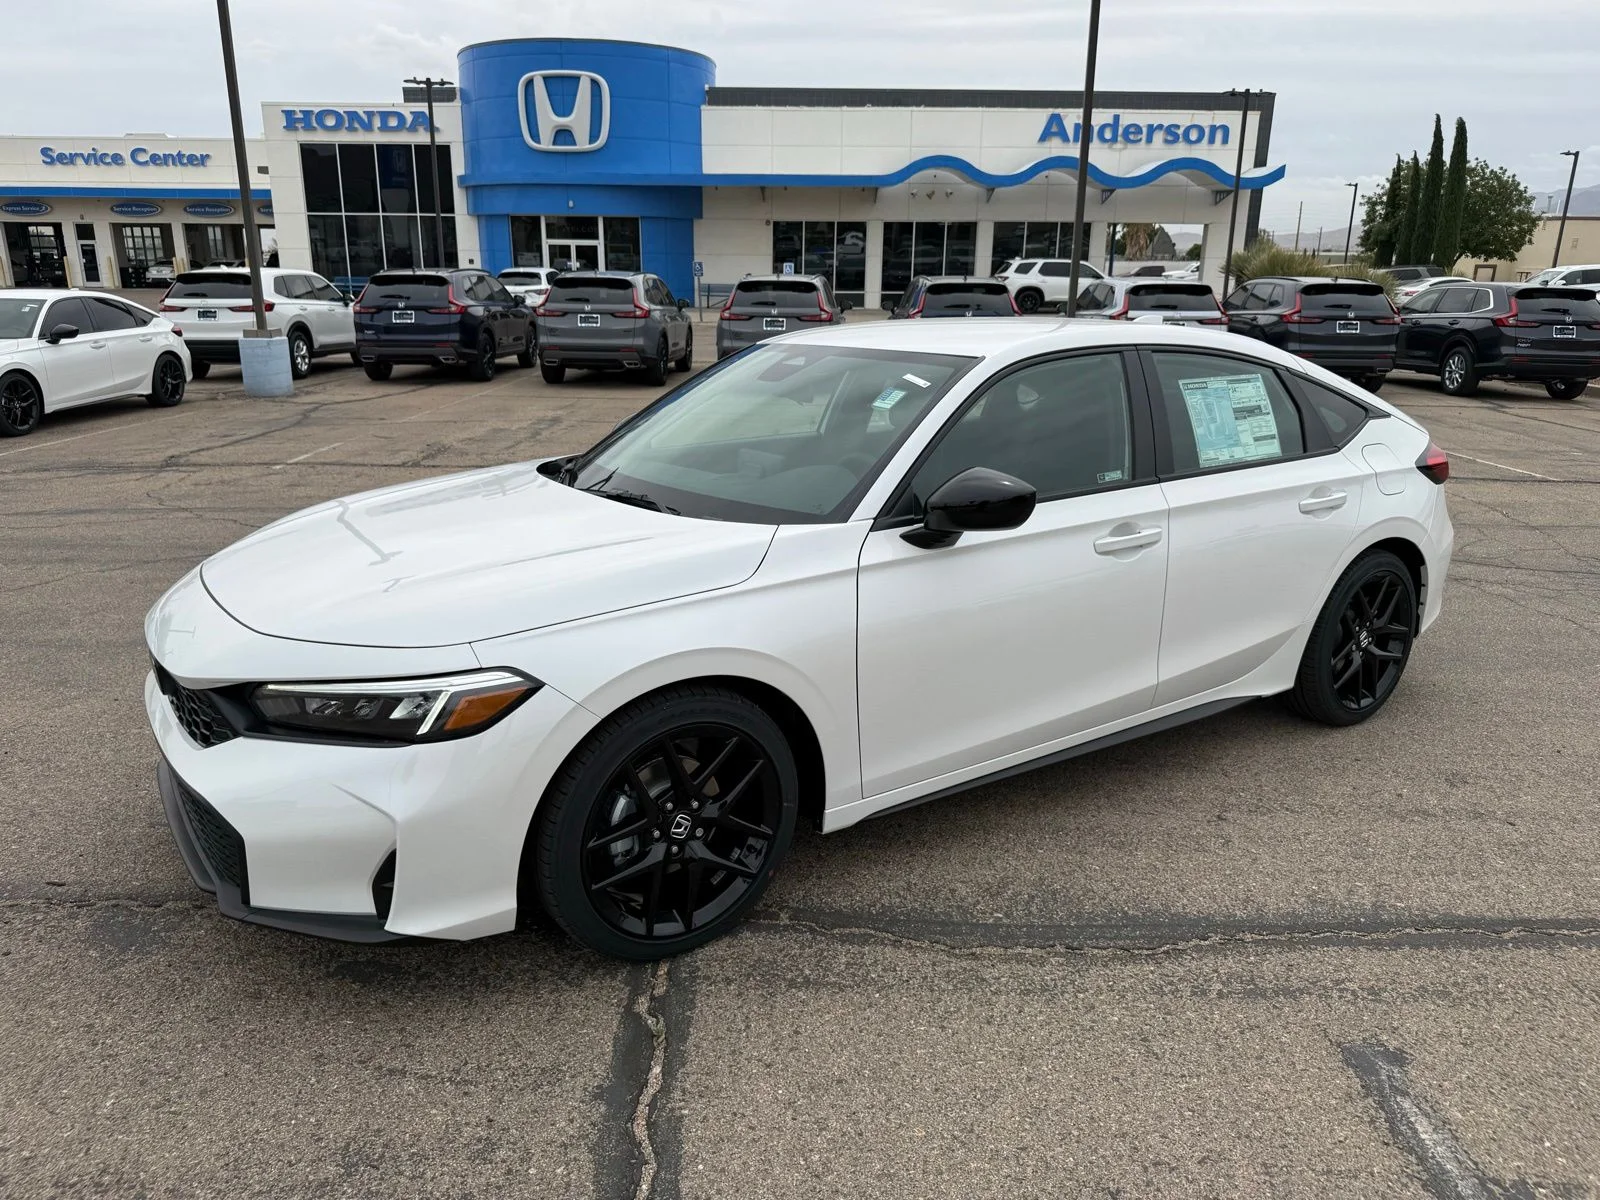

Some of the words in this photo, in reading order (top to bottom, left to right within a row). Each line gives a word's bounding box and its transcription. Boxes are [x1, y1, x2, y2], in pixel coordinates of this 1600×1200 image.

[281, 109, 440, 132] HONDA
[1037, 112, 1230, 145] Anderson
[39, 146, 125, 166] Service
[130, 147, 211, 167] Center
